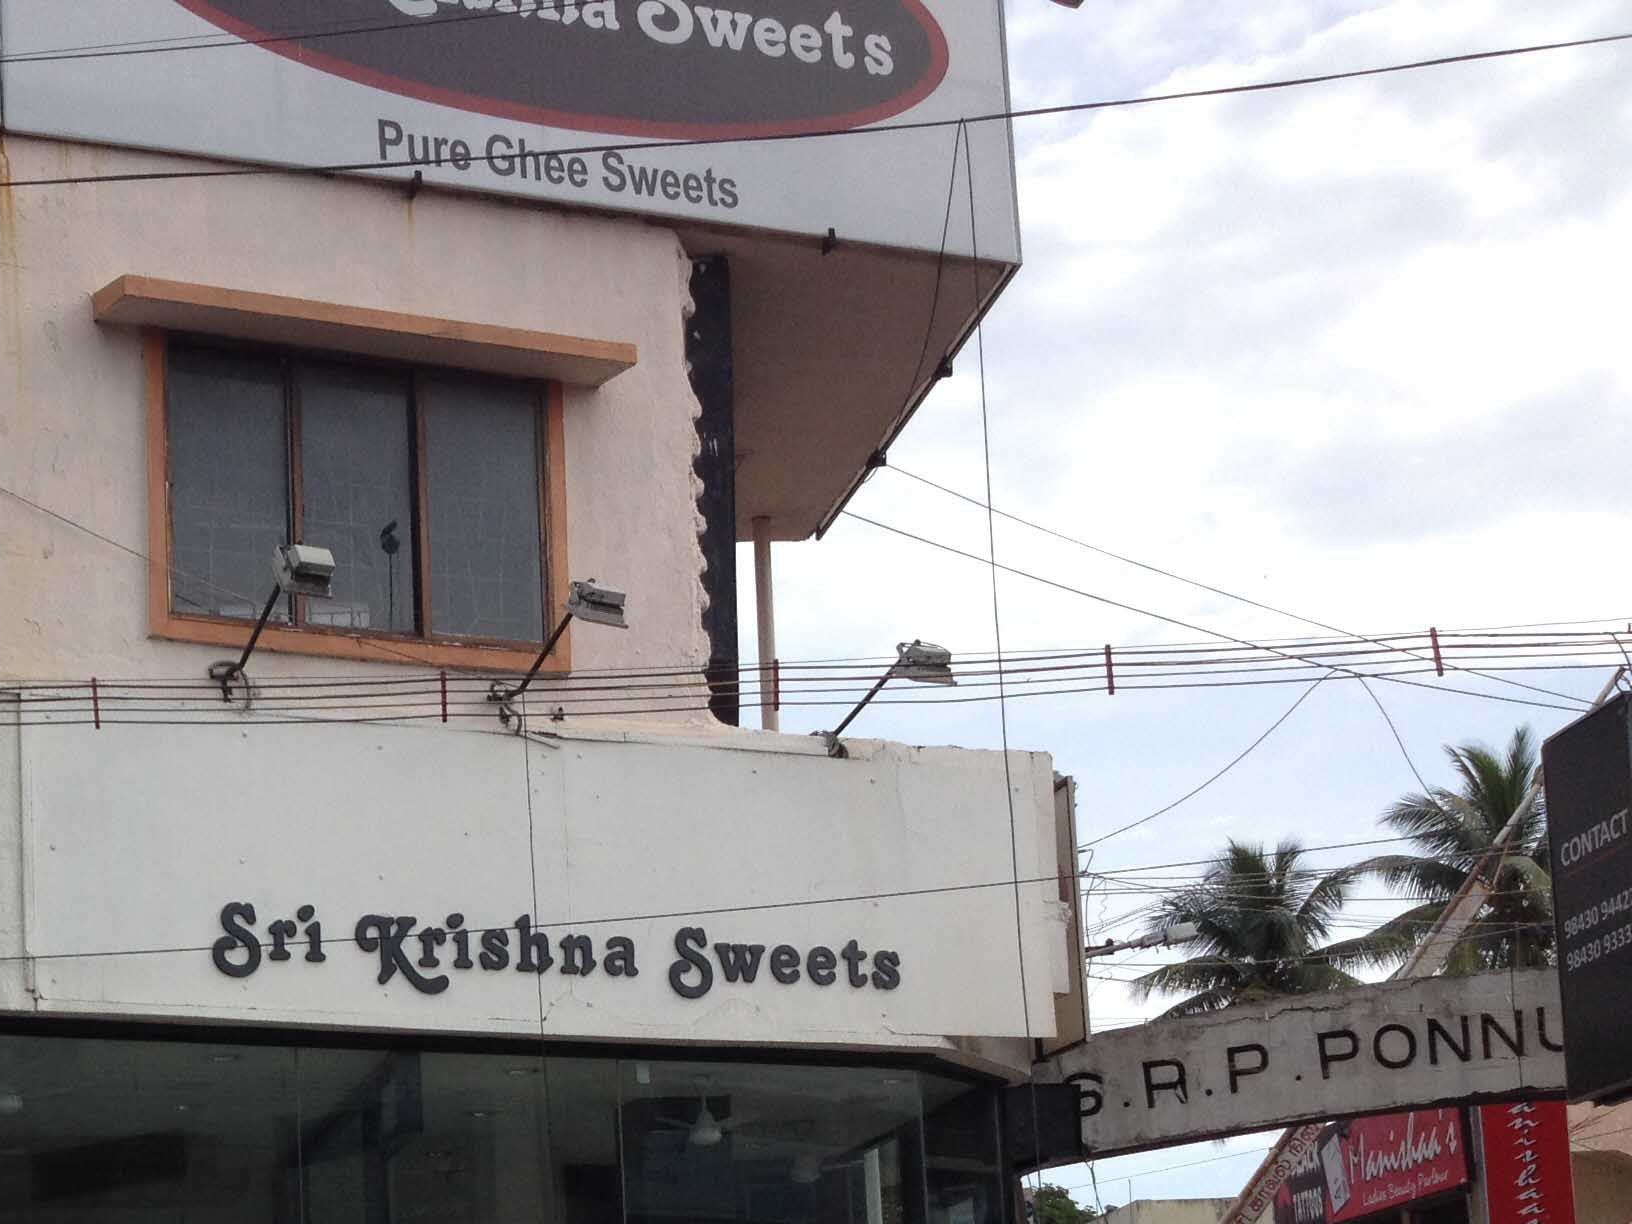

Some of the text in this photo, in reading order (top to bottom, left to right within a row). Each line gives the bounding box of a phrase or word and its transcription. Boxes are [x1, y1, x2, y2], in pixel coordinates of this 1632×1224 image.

[377, 119, 740, 210] Pure Ghee Sweets
[1560, 808, 1628, 867] CONTACT
[211, 902, 902, 999] Sri Krishna Sweets
[1564, 905, 1599, 939] 98430
[1567, 939, 1601, 972] 98430
